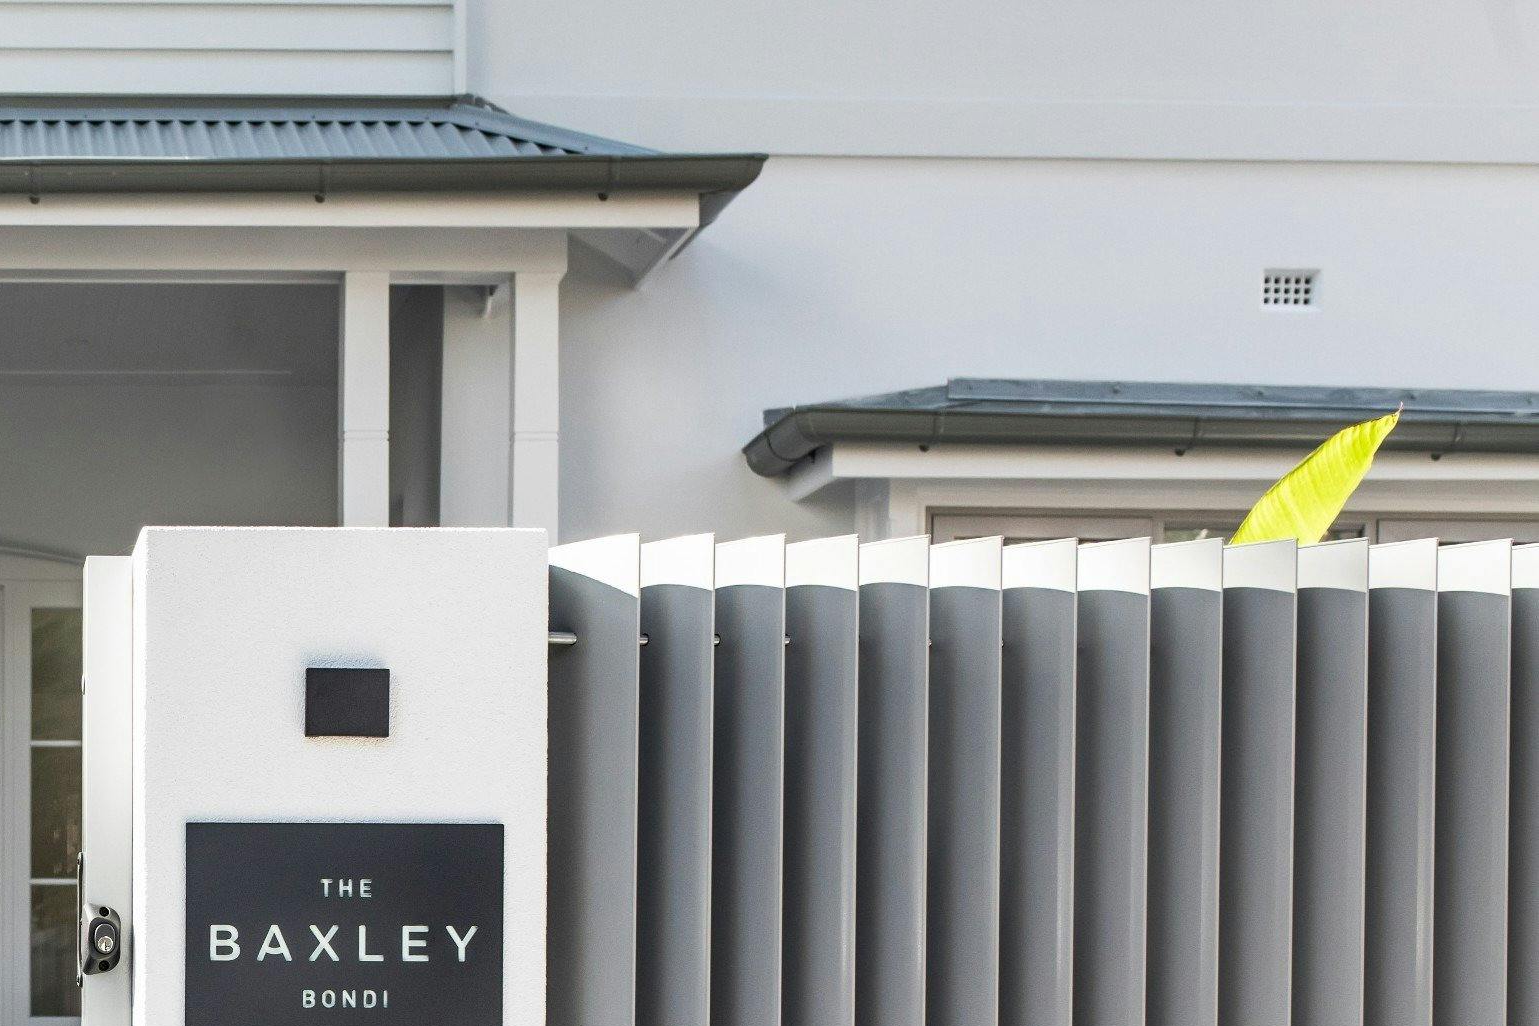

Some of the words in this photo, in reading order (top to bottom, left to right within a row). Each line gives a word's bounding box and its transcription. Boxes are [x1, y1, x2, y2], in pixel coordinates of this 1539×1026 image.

[320, 878, 372, 898] THE
[209, 924, 478, 963] BAXLEY
[302, 989, 388, 1009] BONDI
